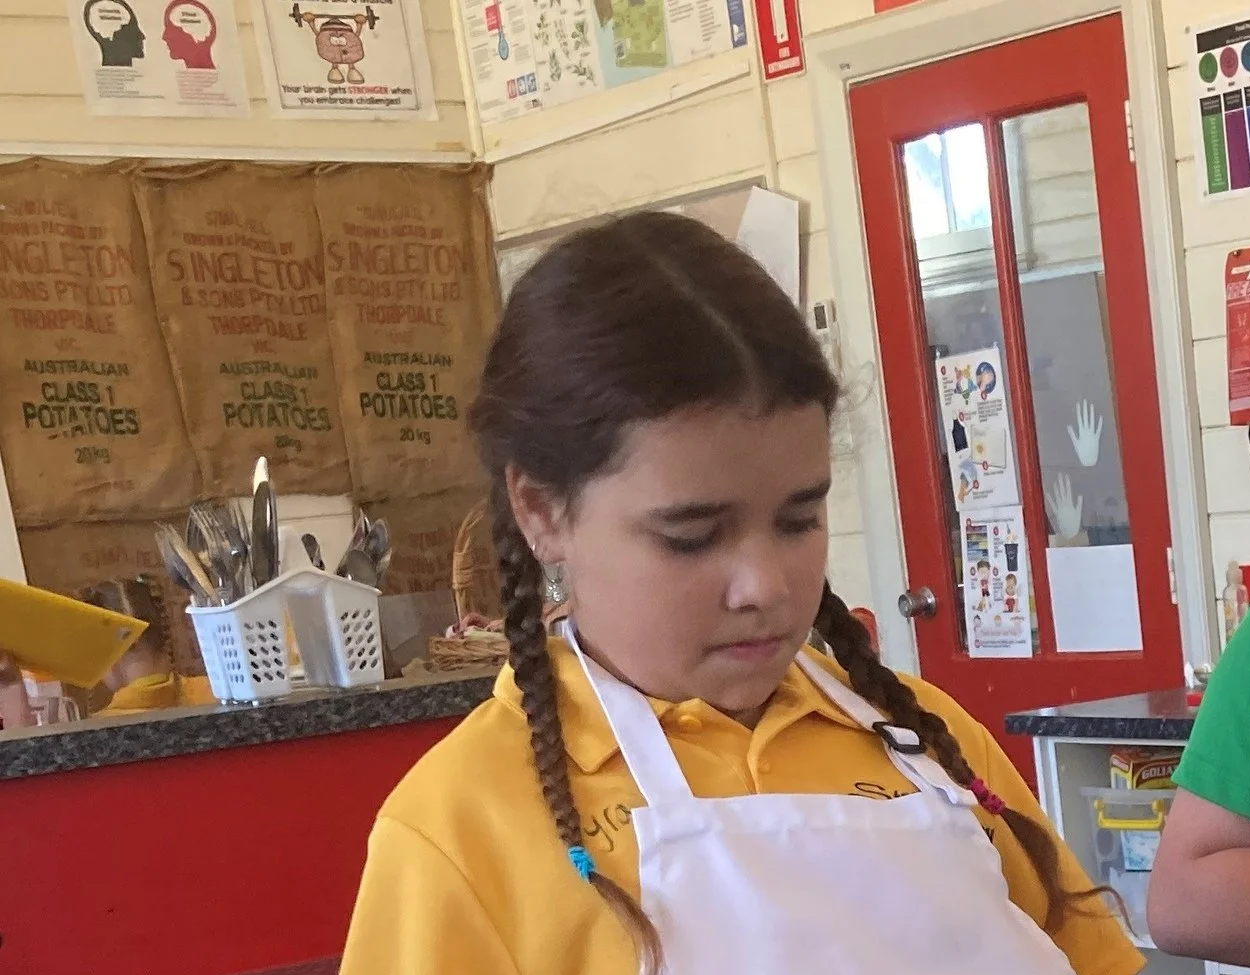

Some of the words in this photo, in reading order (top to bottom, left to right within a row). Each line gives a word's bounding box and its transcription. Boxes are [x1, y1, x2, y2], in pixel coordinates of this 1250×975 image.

[299, 97, 315, 105] you
[328, 87, 346, 95] gets
[0, 241, 137, 277] NGLETON
[167, 248, 326, 291] SINGLETON
[327, 241, 474, 276] SINGLETON
[356, 302, 448, 326] THORPDALE
[208, 314, 308, 341] THORPDALE
[24, 358, 130, 377] AUSTRALIAN
[220, 360, 318, 379] AUSTRALIAN
[363, 352, 454, 367] AUSTRALIAN
[41, 381, 101, 404] CLASS
[105, 385, 115, 406] 1
[240, 381, 297, 404] CLASS
[376, 371, 426, 393] CLASS
[429, 374, 437, 392] 1
[222, 401, 332, 431] POTATOES
[359, 391, 459, 421] POTATOES
[22, 401, 140, 436] POTATOES
[399, 428, 415, 442] 20
[416, 428, 431, 445] kg
[1142, 765, 1175, 780] GOLIA
